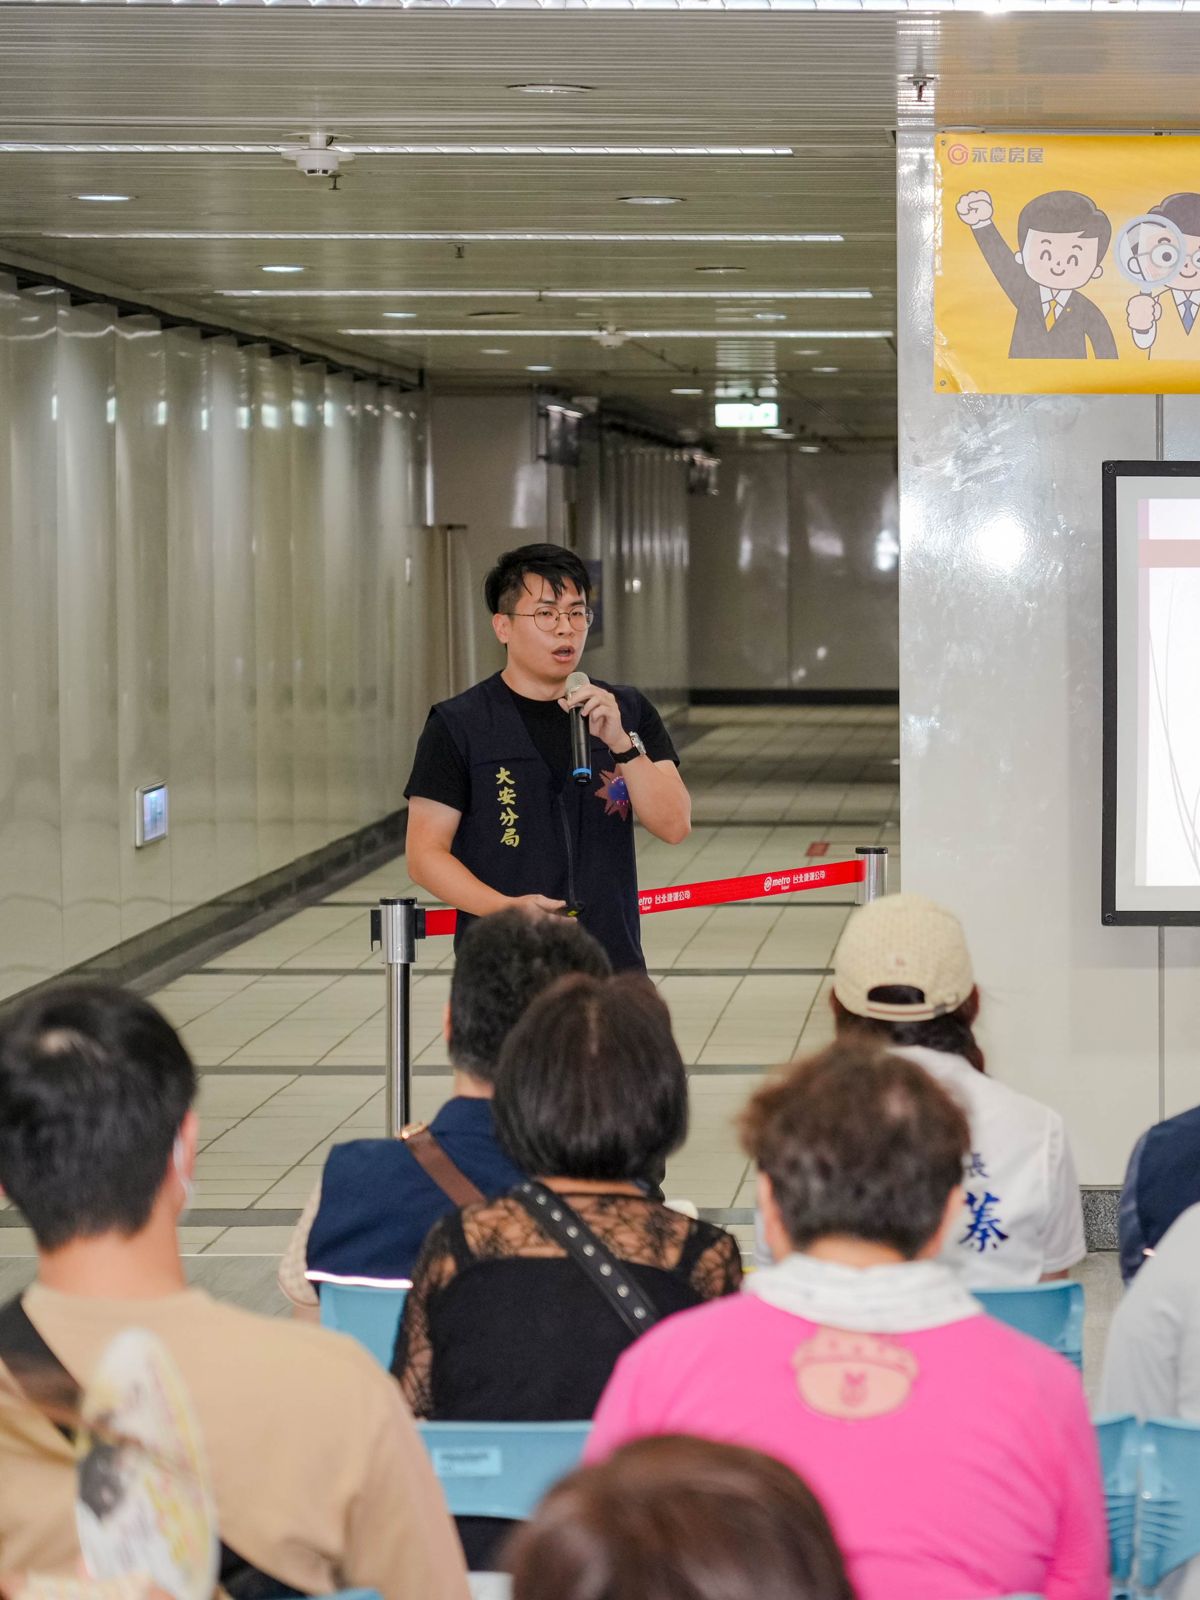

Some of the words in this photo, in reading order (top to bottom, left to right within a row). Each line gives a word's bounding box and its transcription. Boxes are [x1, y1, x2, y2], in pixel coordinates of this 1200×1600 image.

[971, 147, 1044, 163] 永慶房屋
[496, 767, 520, 848] 大安分局
[772, 876, 791, 887] metro
